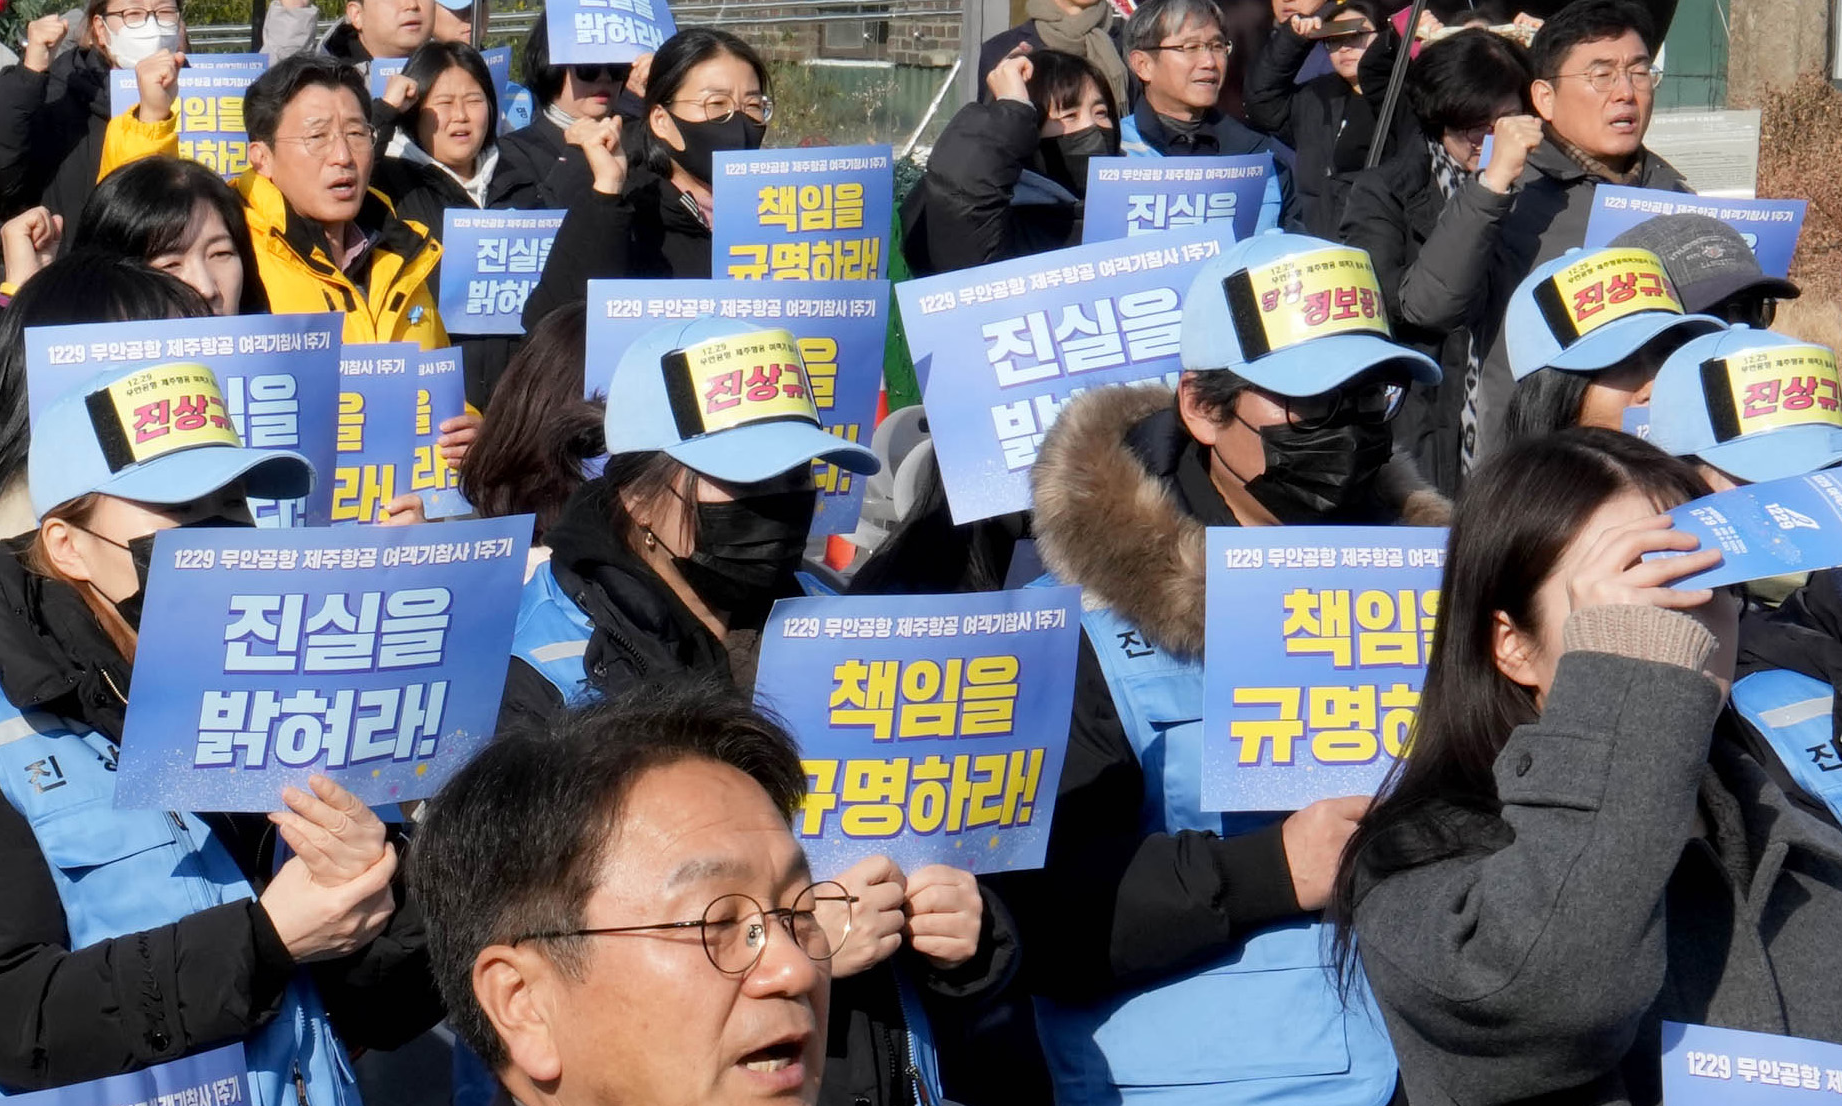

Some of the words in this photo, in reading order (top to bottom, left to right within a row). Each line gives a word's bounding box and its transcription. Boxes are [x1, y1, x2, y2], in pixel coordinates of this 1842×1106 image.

[172, 96, 247, 133] 임을
[725, 162, 747, 176] 1229
[1098, 169, 1120, 181] 1229
[758, 182, 865, 233] 책임을
[1604, 196, 1628, 210] 1229
[727, 237, 881, 280] 규명하라!
[918, 290, 957, 315] 1229
[958, 275, 1027, 306] 무안공항
[1030, 262, 1096, 292] 제주항공
[1099, 247, 1179, 278] 여객기참사
[1181, 239, 1221, 263] 1주기
[466, 279, 539, 316] 밝혀
[606, 300, 641, 318] 1229
[646, 299, 716, 318] 무안공항
[719, 300, 781, 318] 제주항공
[785, 300, 848, 318] 여객기참사
[849, 300, 876, 317] 1주기
[47, 345, 86, 365] 1229
[90, 341, 162, 361] 무안공항
[166, 335, 234, 359] 제주항공
[238, 332, 302, 355] 여객기참사
[303, 331, 331, 351] 1주기
[981, 286, 1183, 390] 진실을
[339, 358, 374, 376] 기참사
[376, 358, 406, 375] 1주기
[705, 363, 809, 414] 진상규
[1742, 376, 1842, 419] 진상규
[132, 394, 232, 445] 진상규
[174, 547, 216, 570] 1229
[219, 545, 298, 570] 무안공항
[301, 543, 378, 570] 제주항공
[381, 540, 471, 569] 여객기참사
[472, 536, 515, 561] 1주기
[1224, 547, 1264, 568] 1229
[1266, 547, 1337, 569] 무안공항
[1339, 546, 1406, 569] 제주항공
[221, 585, 453, 676] 진실을
[782, 617, 820, 639] 1229
[824, 614, 893, 638] 무안공항
[895, 613, 960, 637] 제주항공
[962, 610, 1032, 635] 여객기참사
[1033, 608, 1067, 630] 1주기
[828, 654, 1021, 741] 책임을
[194, 680, 448, 771] 밝혀라!
[800, 748, 1046, 838] 규명하라!
[1686, 1050, 1733, 1083] 1229
[1736, 1057, 1822, 1091] 무안공항
